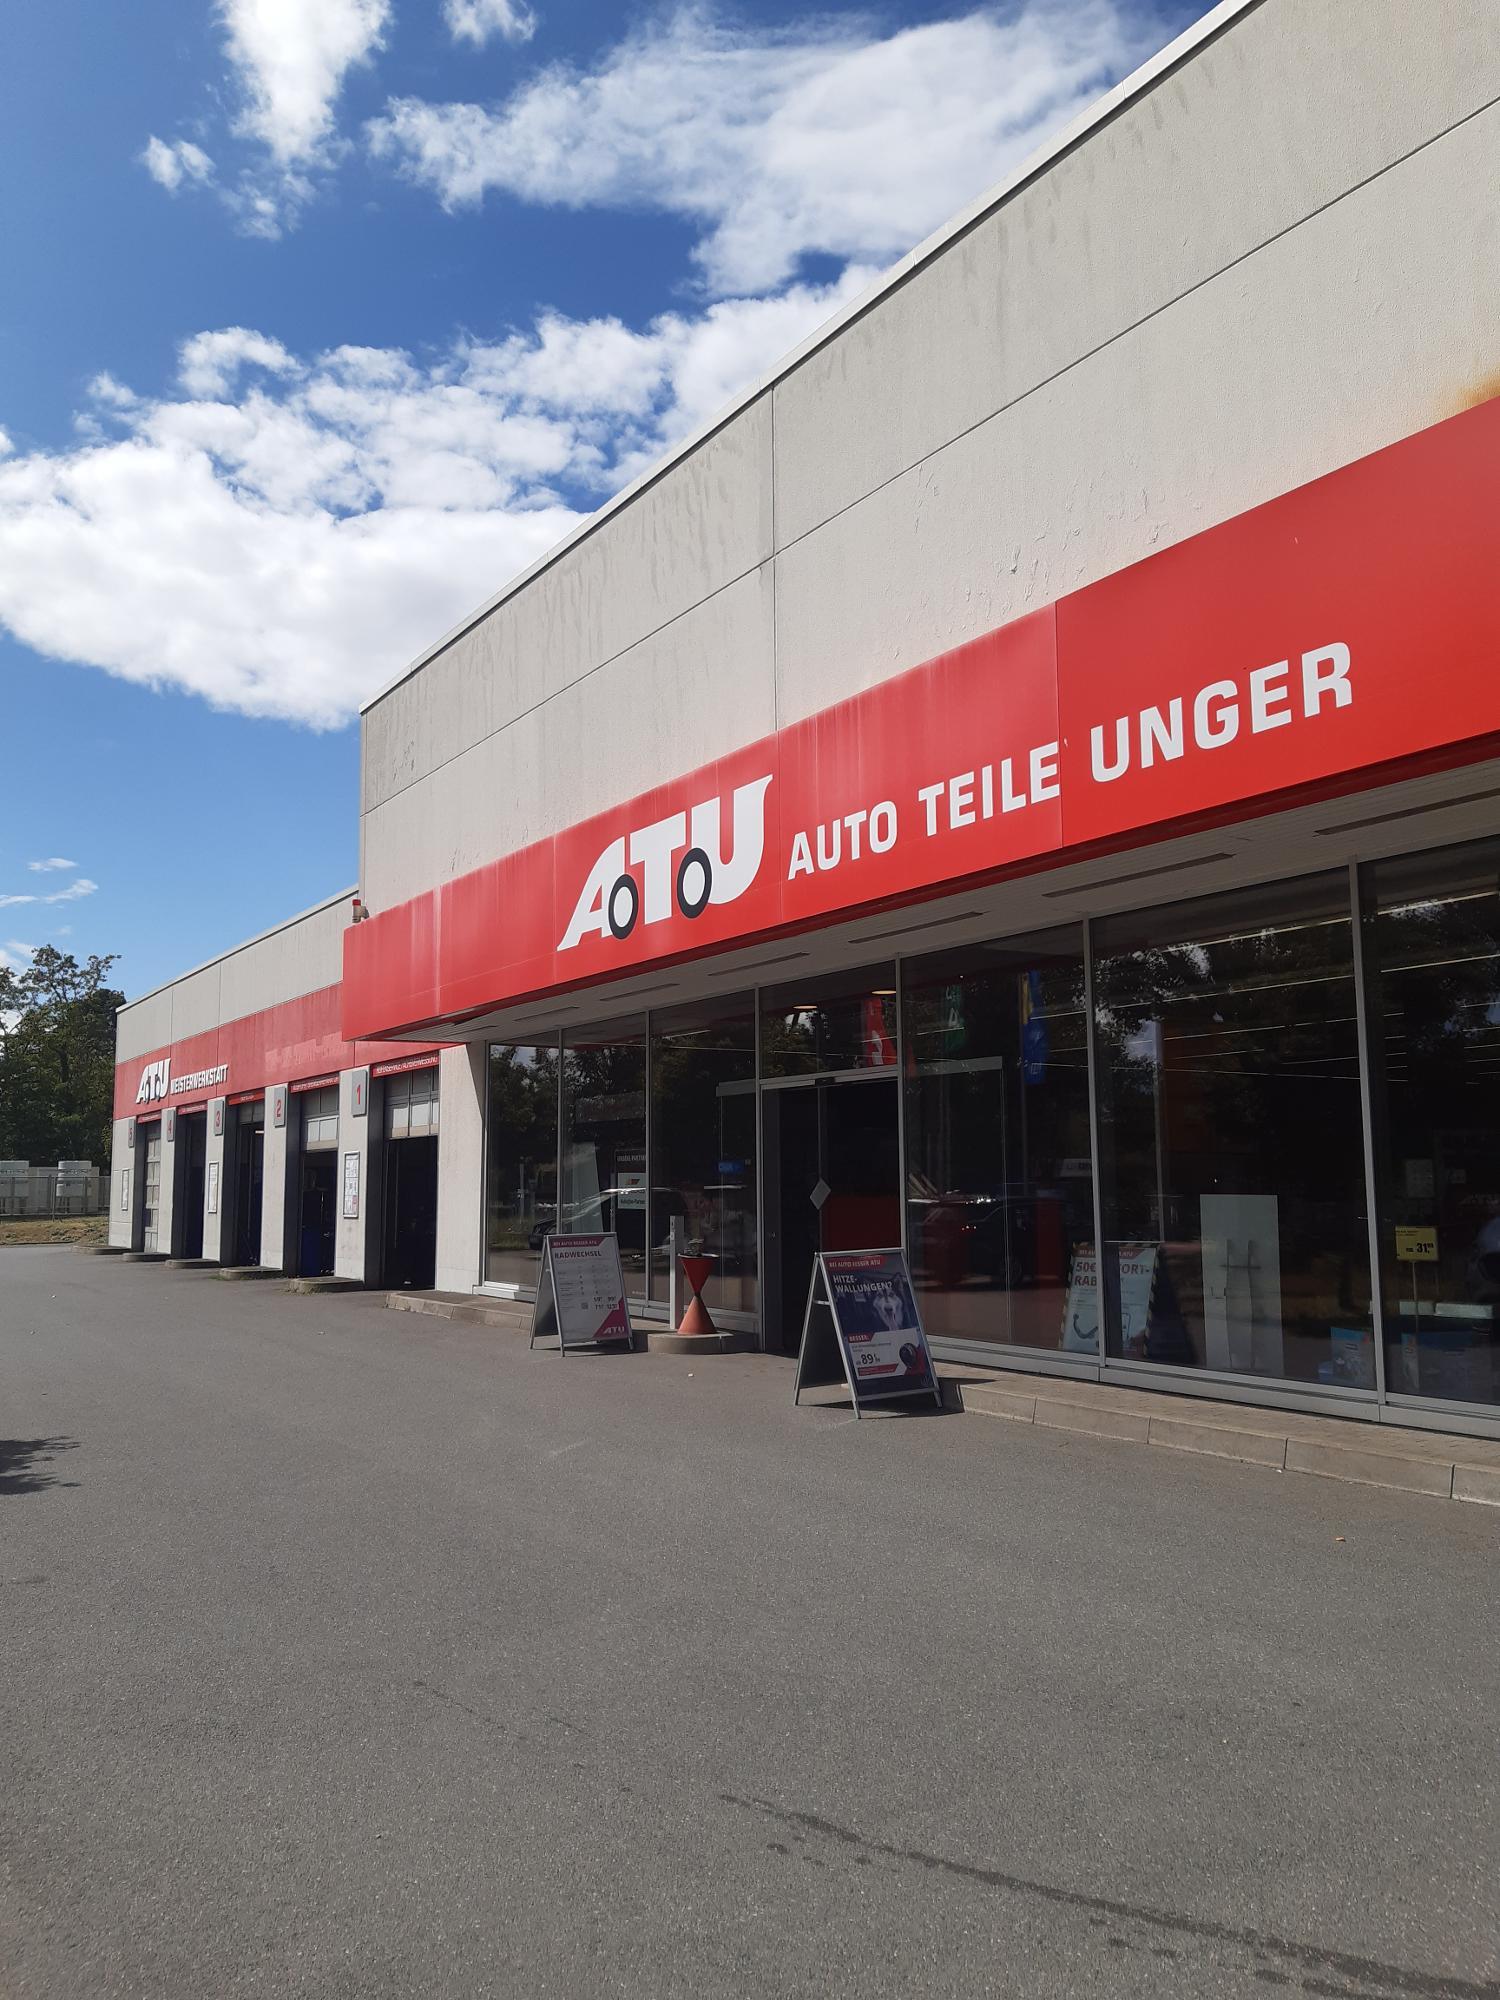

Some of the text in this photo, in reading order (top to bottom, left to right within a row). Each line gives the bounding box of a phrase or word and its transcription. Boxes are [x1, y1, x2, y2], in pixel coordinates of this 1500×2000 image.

[788, 801, 898, 880] AUTO
[918, 740, 1060, 837] TEILE
[1090, 641, 1353, 783] UNGER
[170, 1064, 228, 1095] MEISTERWERKSTATT
[275, 1099, 282, 1118] 2
[215, 1110, 221, 1127] 3
[554, 1250, 602, 1259] RADWECHSEL
[835, 1281, 893, 1293] WALLUNGEN?
[603, 1326, 625, 1335] ATU
